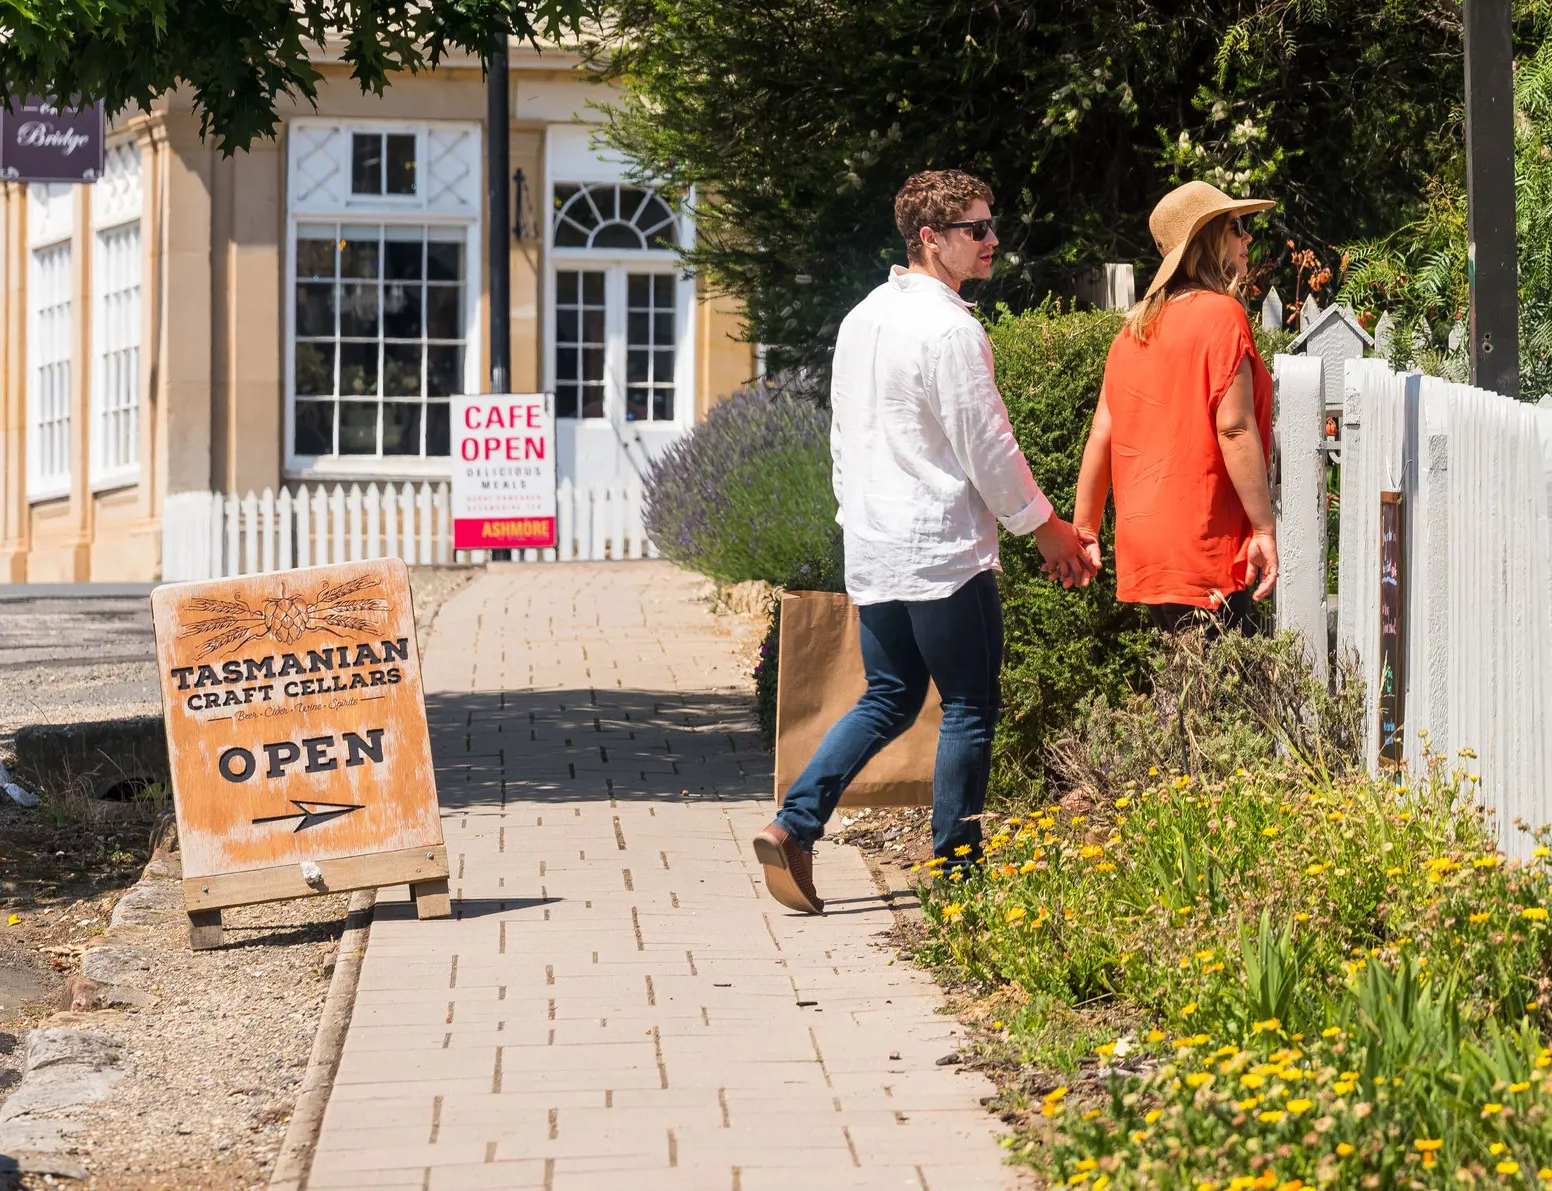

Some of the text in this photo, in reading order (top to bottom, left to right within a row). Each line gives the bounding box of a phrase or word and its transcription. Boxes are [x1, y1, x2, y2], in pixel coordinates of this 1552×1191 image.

[17, 121, 89, 156] Bridge
[464, 405, 542, 430] CAFE
[461, 436, 546, 462] OPEN
[466, 467, 542, 477] DELICIOUS
[481, 481, 527, 489] MEALS
[481, 520, 550, 538] ASHMORE
[171, 637, 409, 691] TASMANIAN
[187, 667, 402, 711] CRAFT CELLARS
[234, 697, 358, 722] Beer Cider Wine Spirits
[218, 728, 385, 783] OPEN
